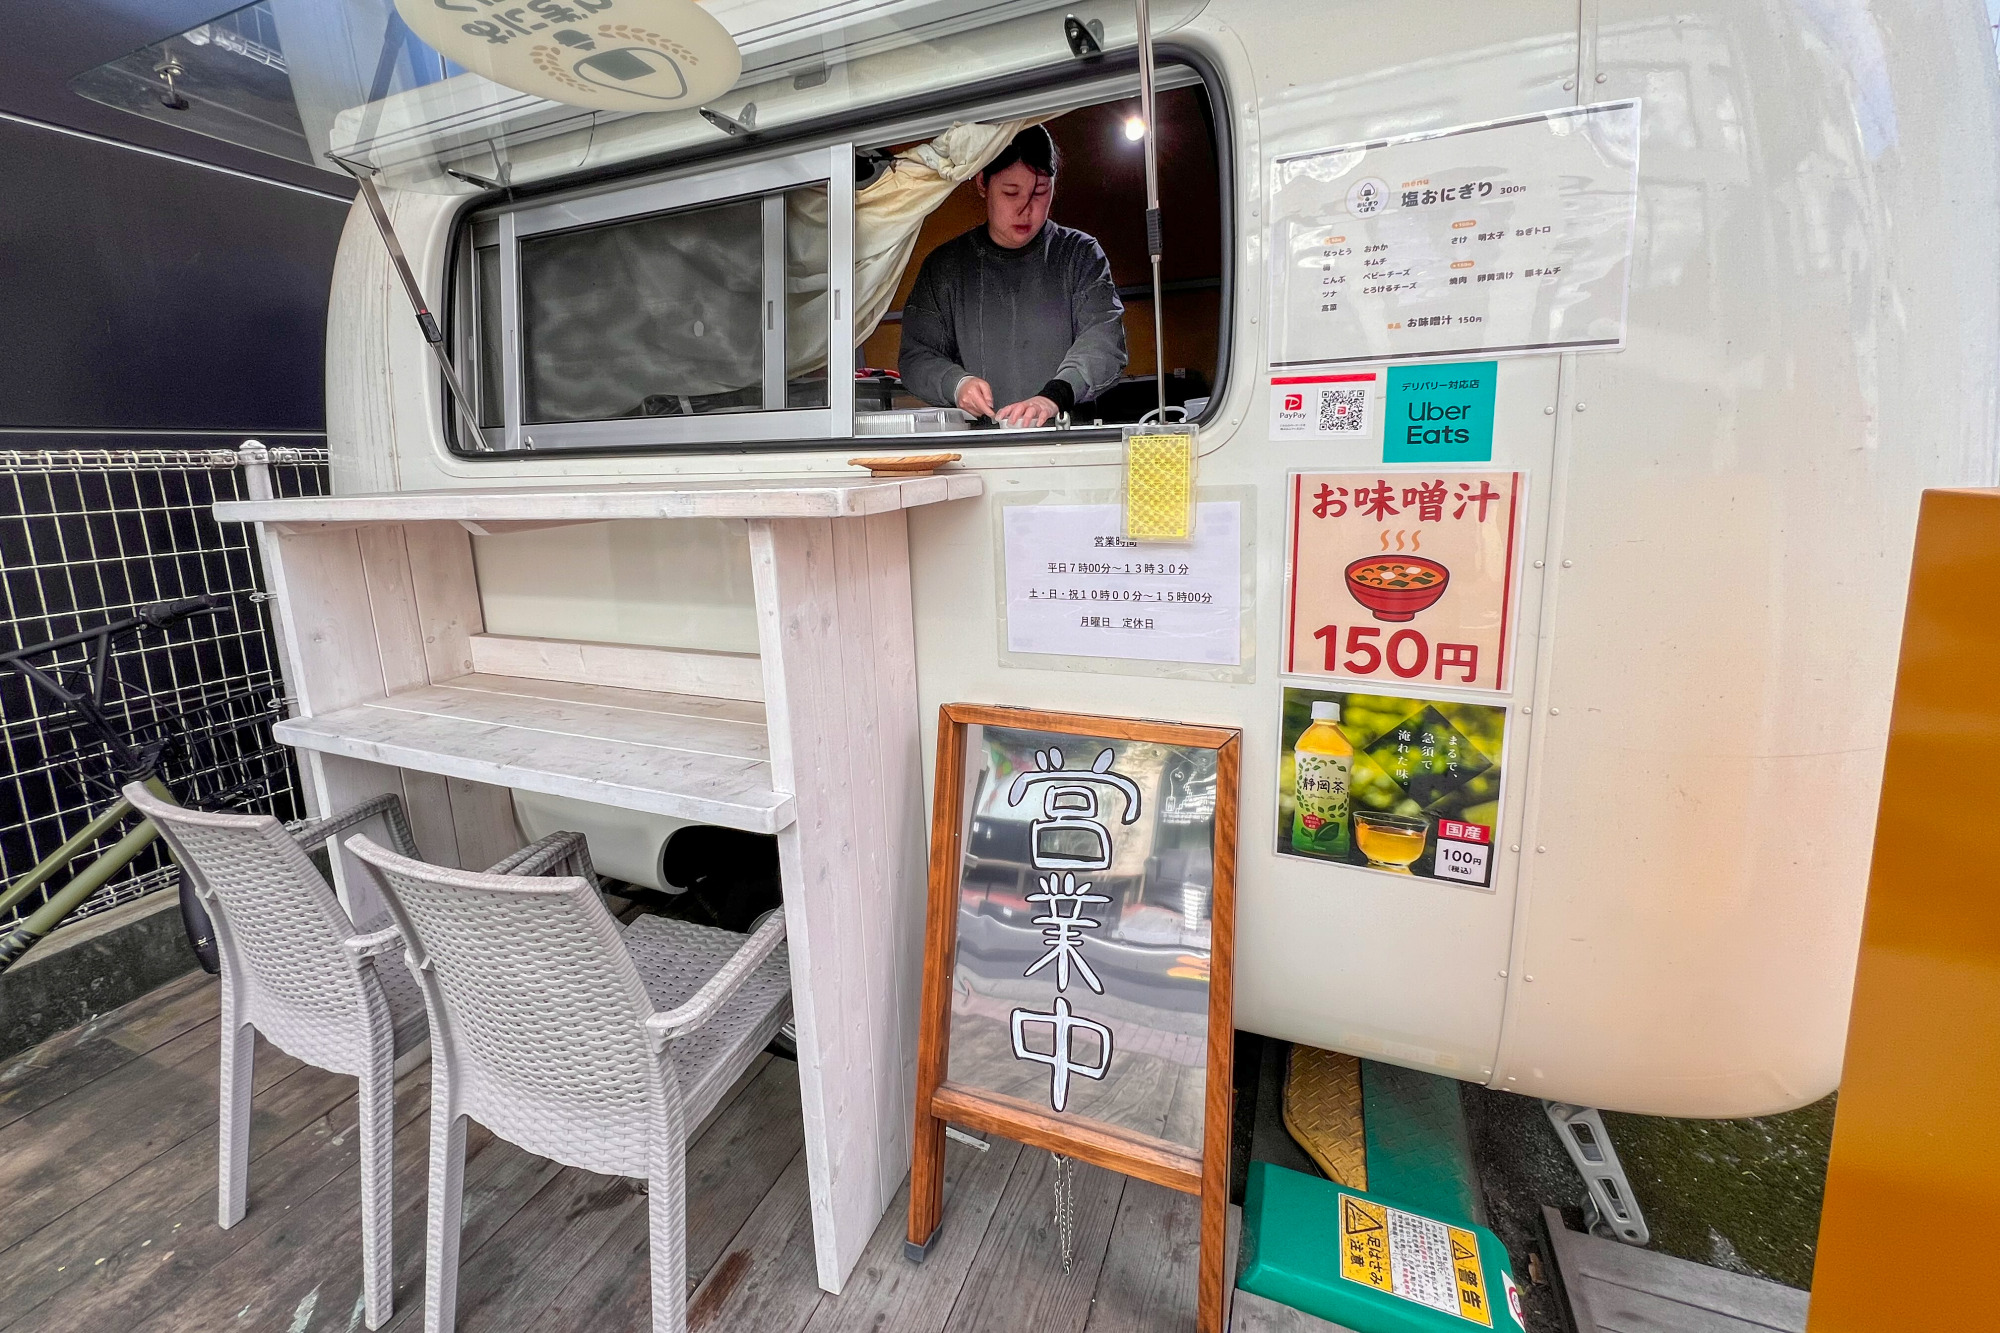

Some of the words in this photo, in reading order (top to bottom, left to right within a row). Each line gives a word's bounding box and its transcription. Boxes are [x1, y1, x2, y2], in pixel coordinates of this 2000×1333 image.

[1401, 178, 1429, 188] menu
[1401, 181, 1493, 207] 塩おにぎり
[1500, 185, 1527, 195] 300円
[1451, 236, 1468, 244] さけ
[1478, 231, 1504, 241] 明太子
[1516, 226, 1551, 236] ねぎトロ
[1323, 248, 1352, 257] なっとう
[1364, 244, 1388, 253] おかか
[1364, 258, 1387, 267] キムチ
[1323, 275, 1346, 285] こんぶ
[1363, 268, 1411, 280] ベビーチーズ
[1322, 290, 1337, 298] ツナ
[1363, 282, 1418, 294] とろけるチーズ
[1407, 315, 1452, 328] お味噌汁
[1458, 316, 1482, 324] 150円
[1402, 379, 1480, 391] デリバリー対応店
[1279, 412, 1306, 420] PayPay
[1408, 402, 1471, 421] Uber
[1407, 425, 1470, 445] Eats
[1312, 479, 1500, 522] お味噌汁
[1080, 616, 1111, 628] 月曜日
[1122, 617, 1154, 629] 定休日
[1313, 624, 1479, 682] 150円
[1396, 729, 1411, 786] 淹れた味。
[1421, 732, 1435, 770] 急須で
[1446, 735, 1459, 778] まるで、
[1446, 822, 1482, 840] 国産
[1443, 848, 1482, 866] 100円
[1448, 865, 1472, 875] (税込)
[1008, 746, 1141, 1112] 営業中
[1350, 1239, 1365, 1267] 注意
[1367, 1234, 1383, 1285] 足はさみ
[1458, 1268, 1482, 1310] 警告
